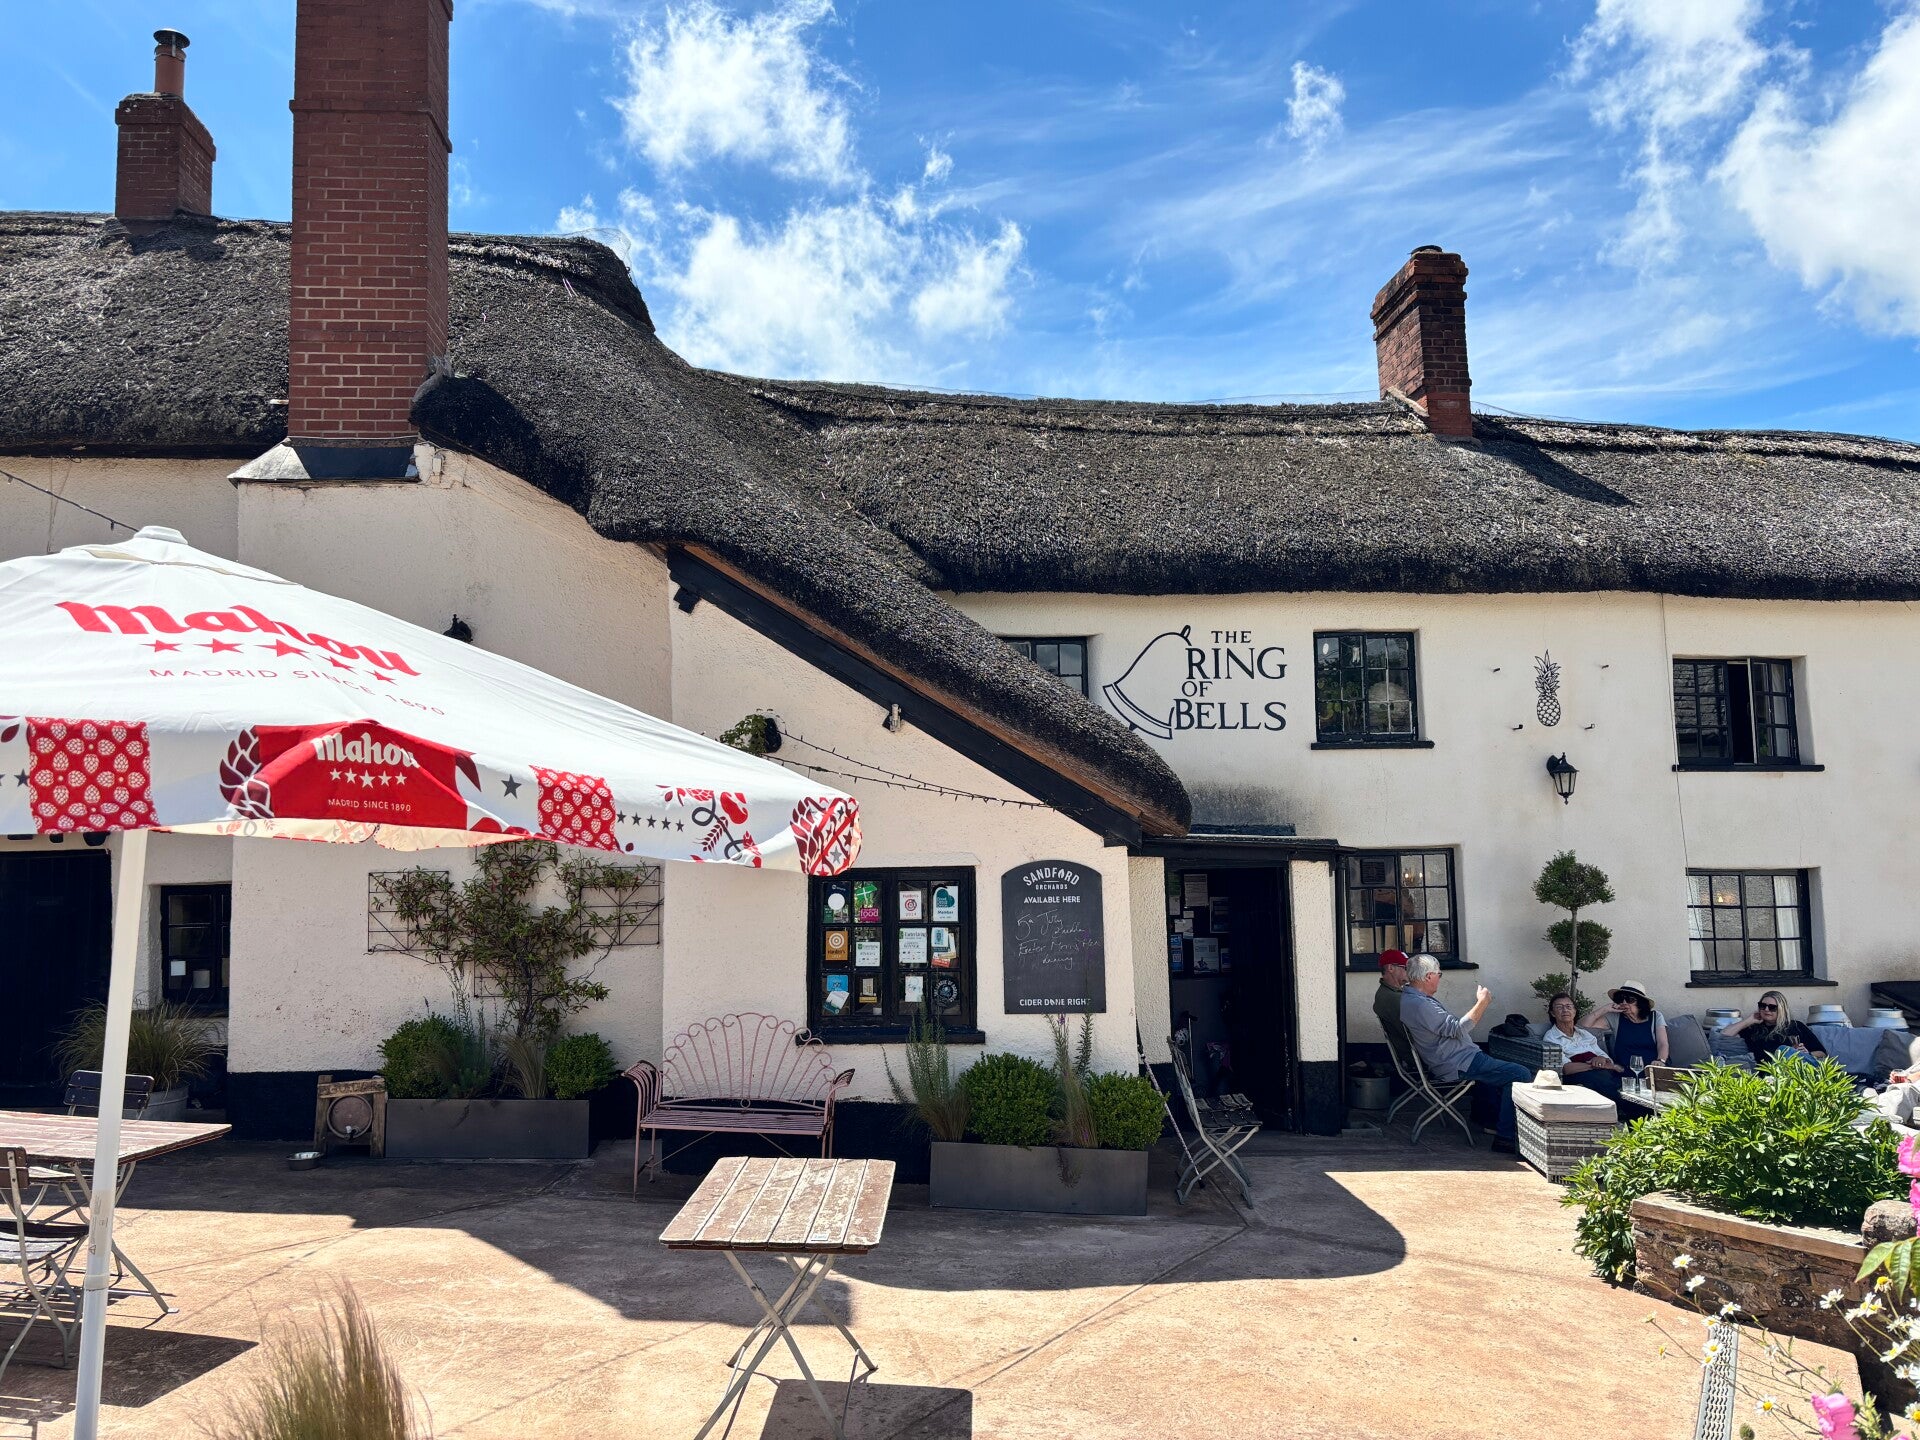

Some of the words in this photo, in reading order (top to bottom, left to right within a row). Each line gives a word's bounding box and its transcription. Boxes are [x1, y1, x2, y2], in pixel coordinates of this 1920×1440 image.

[1210, 630, 1252, 644] THE
[1185, 646, 1287, 680] RING
[149, 669, 279, 679] MADRID
[291, 669, 377, 696] SINCE
[385, 693, 445, 716] 1890
[1181, 680, 1213, 698] OF
[1173, 698, 1287, 731] BELLS
[328, 799, 360, 808] MADRID
[363, 800, 389, 810] SINCE
[391, 803, 411, 812] 1890
[1023, 867, 1080, 886] SANDFORD
[1023, 895, 1061, 904] AVAILABLE
[1062, 895, 1081, 903] HERE
[860, 907, 879, 919] food
[1019, 998, 1042, 1007] CIDER
[1044, 998, 1065, 1006] DONE
